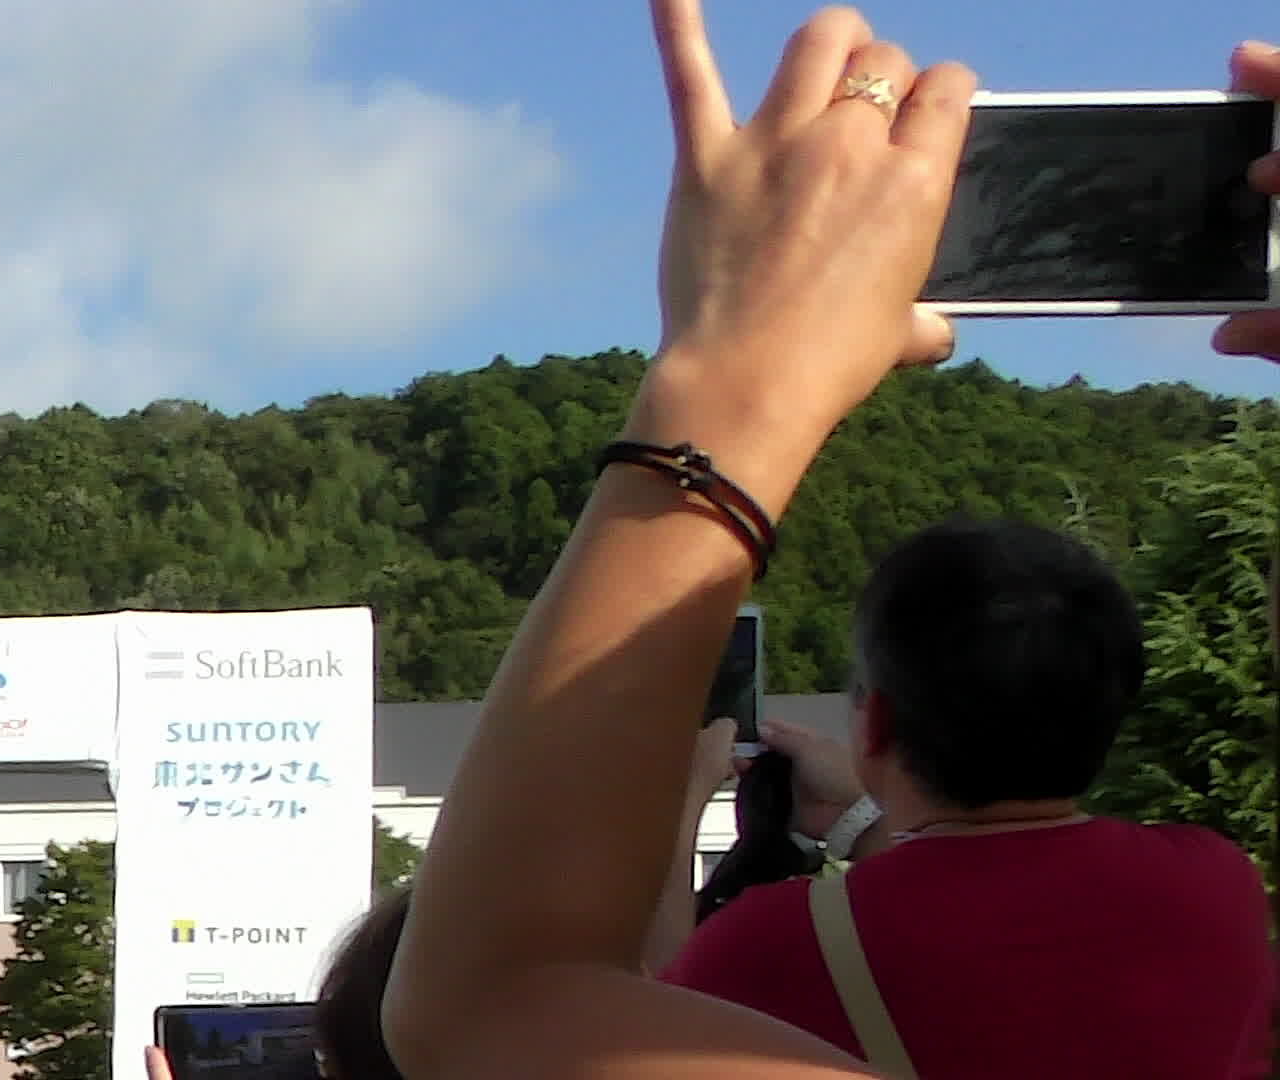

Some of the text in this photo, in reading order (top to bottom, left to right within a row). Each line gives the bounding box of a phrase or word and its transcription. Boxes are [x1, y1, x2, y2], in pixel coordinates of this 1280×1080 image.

[195, 649, 343, 679] SoftBank
[166, 721, 321, 742] SUNTORY
[205, 926, 308, 944] T-POINT
